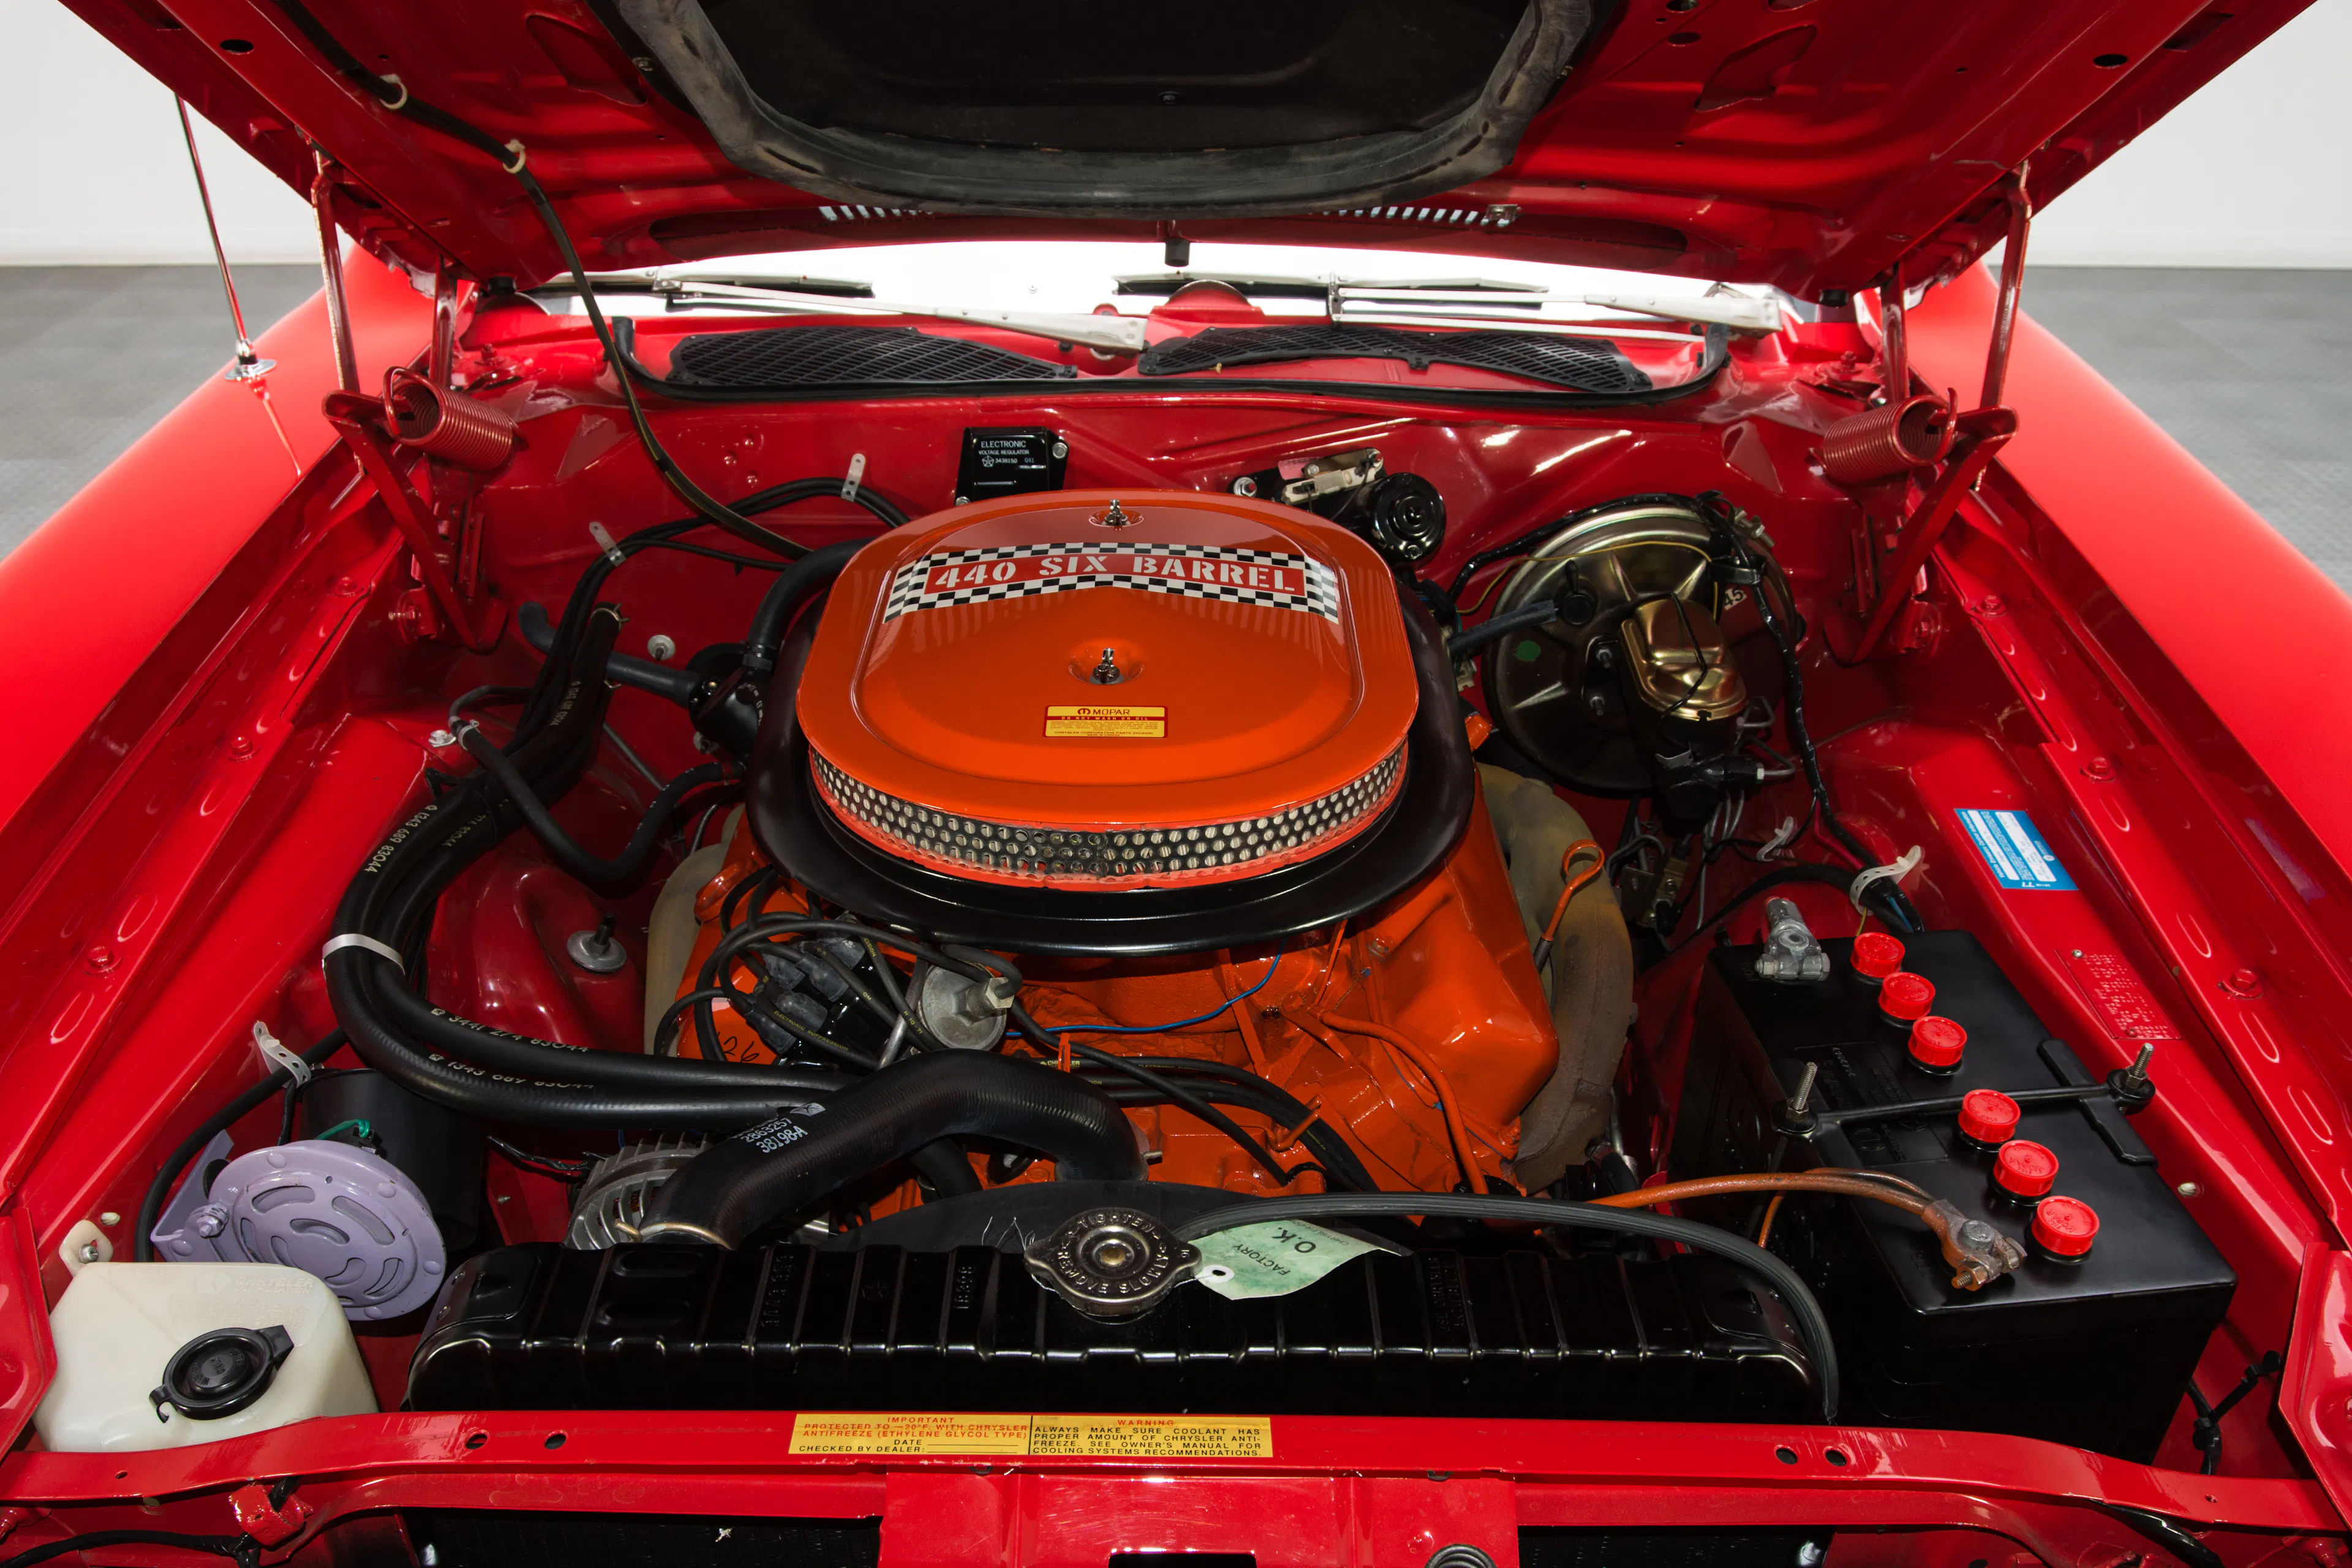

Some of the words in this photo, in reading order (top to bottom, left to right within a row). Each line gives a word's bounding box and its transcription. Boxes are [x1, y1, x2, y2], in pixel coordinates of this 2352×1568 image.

[981, 440, 1027, 448] ELECTRONIC
[935, 561, 1017, 588] 440
[1039, 555, 1108, 576] SIX
[1133, 556, 1295, 592] BARREL
[405, 812, 430, 827] 1343
[390, 828, 410, 843] 689
[363, 845, 394, 873] 83044
[448, 1015, 484, 1031] 3441
[774, 1009, 805, 1031] ELECTRONIC
[807, 1029, 849, 1052] SUPPRESSION
[447, 1061, 486, 1076] 1343
[1077, 1213, 1156, 1233] TIGHTEN
[1271, 1227, 1316, 1253] O.K.
[1232, 1243, 1291, 1276] FACTORY
[1057, 1251, 1109, 1294] REMOVE
[1118, 1254, 1169, 1294] SLOWLY
[993, 1431, 1028, 1439] TYPE)
[1144, 1448, 1262, 1457] RECOMMENDATIONS.
